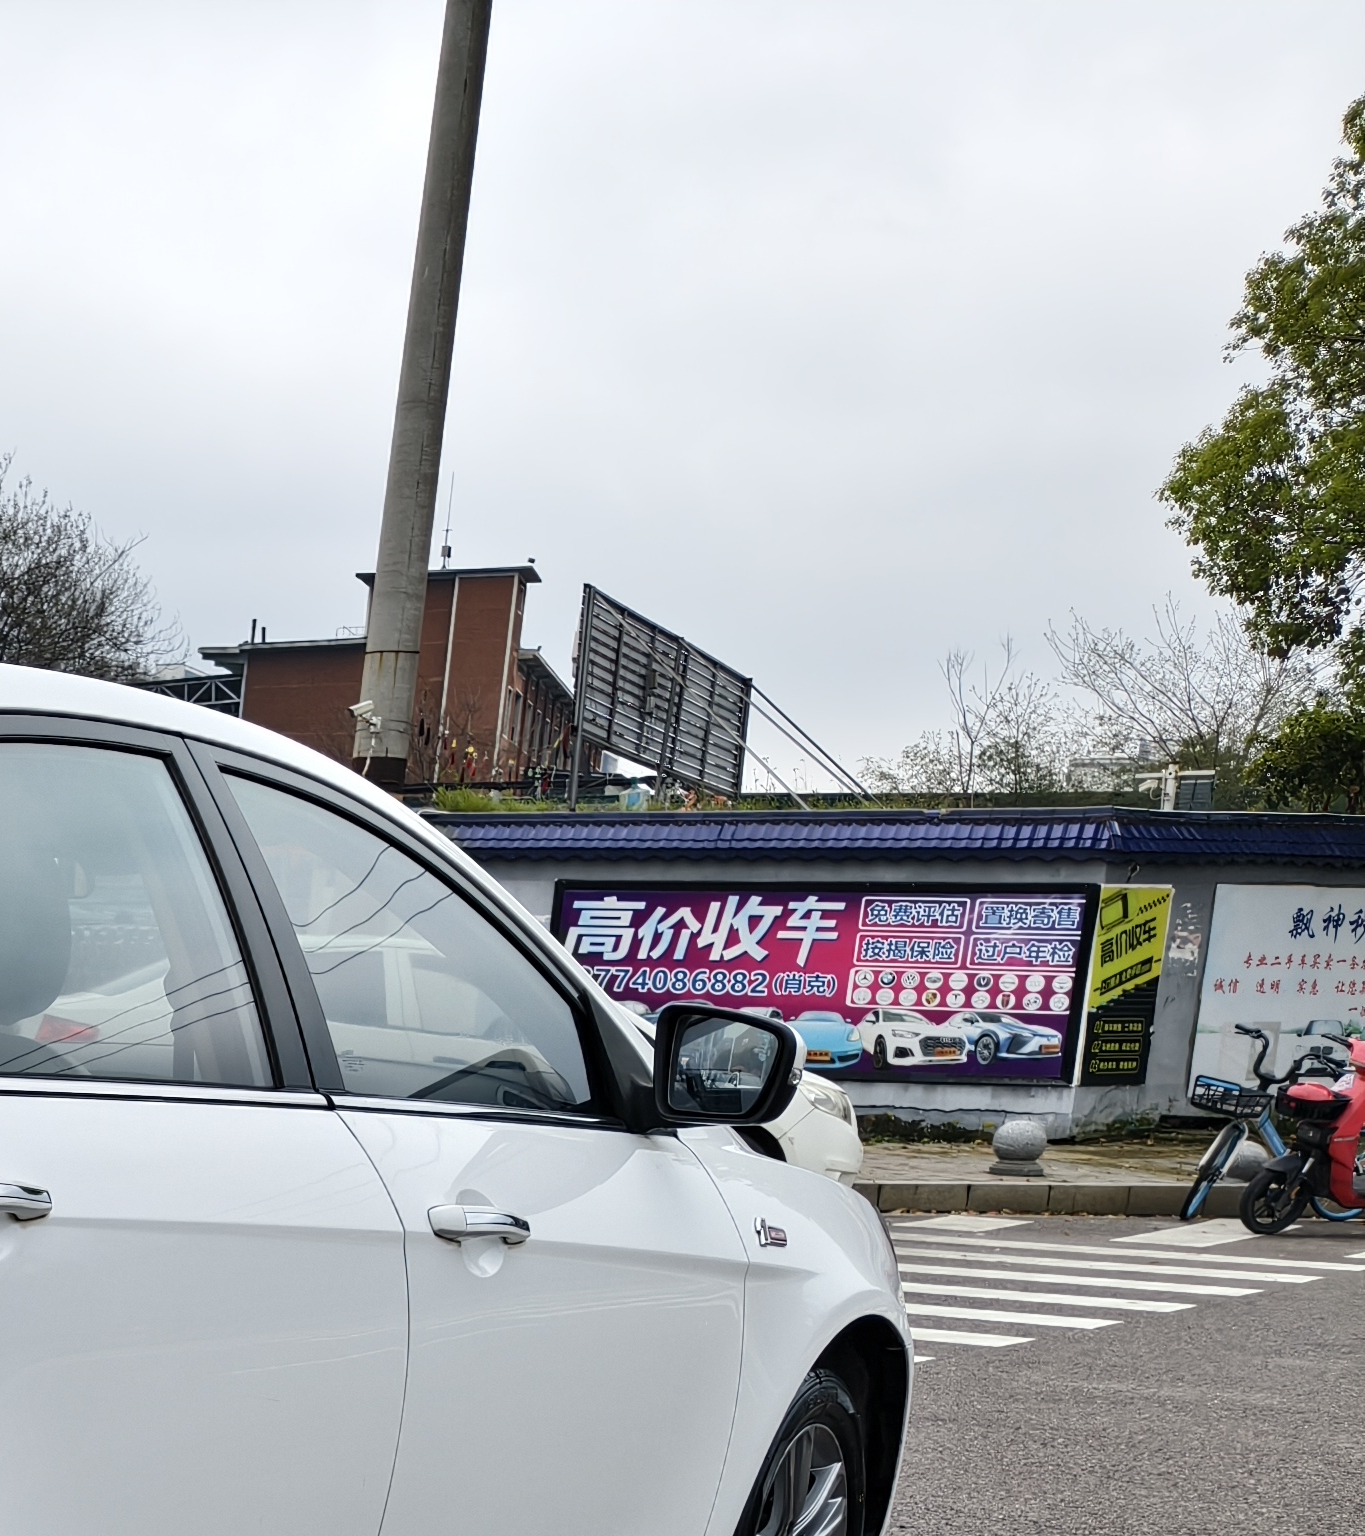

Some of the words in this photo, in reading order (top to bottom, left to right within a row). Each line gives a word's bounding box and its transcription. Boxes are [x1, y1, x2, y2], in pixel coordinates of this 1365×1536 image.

[564, 895, 846, 967] 高价收车
[866, 902, 963, 927] 免费评估
[979, 904, 1081, 929] 置换寄售
[861, 938, 957, 962] 按揭保险
[975, 940, 1075, 964] 过户年检
[1100, 916, 1157, 967] 高价收车
